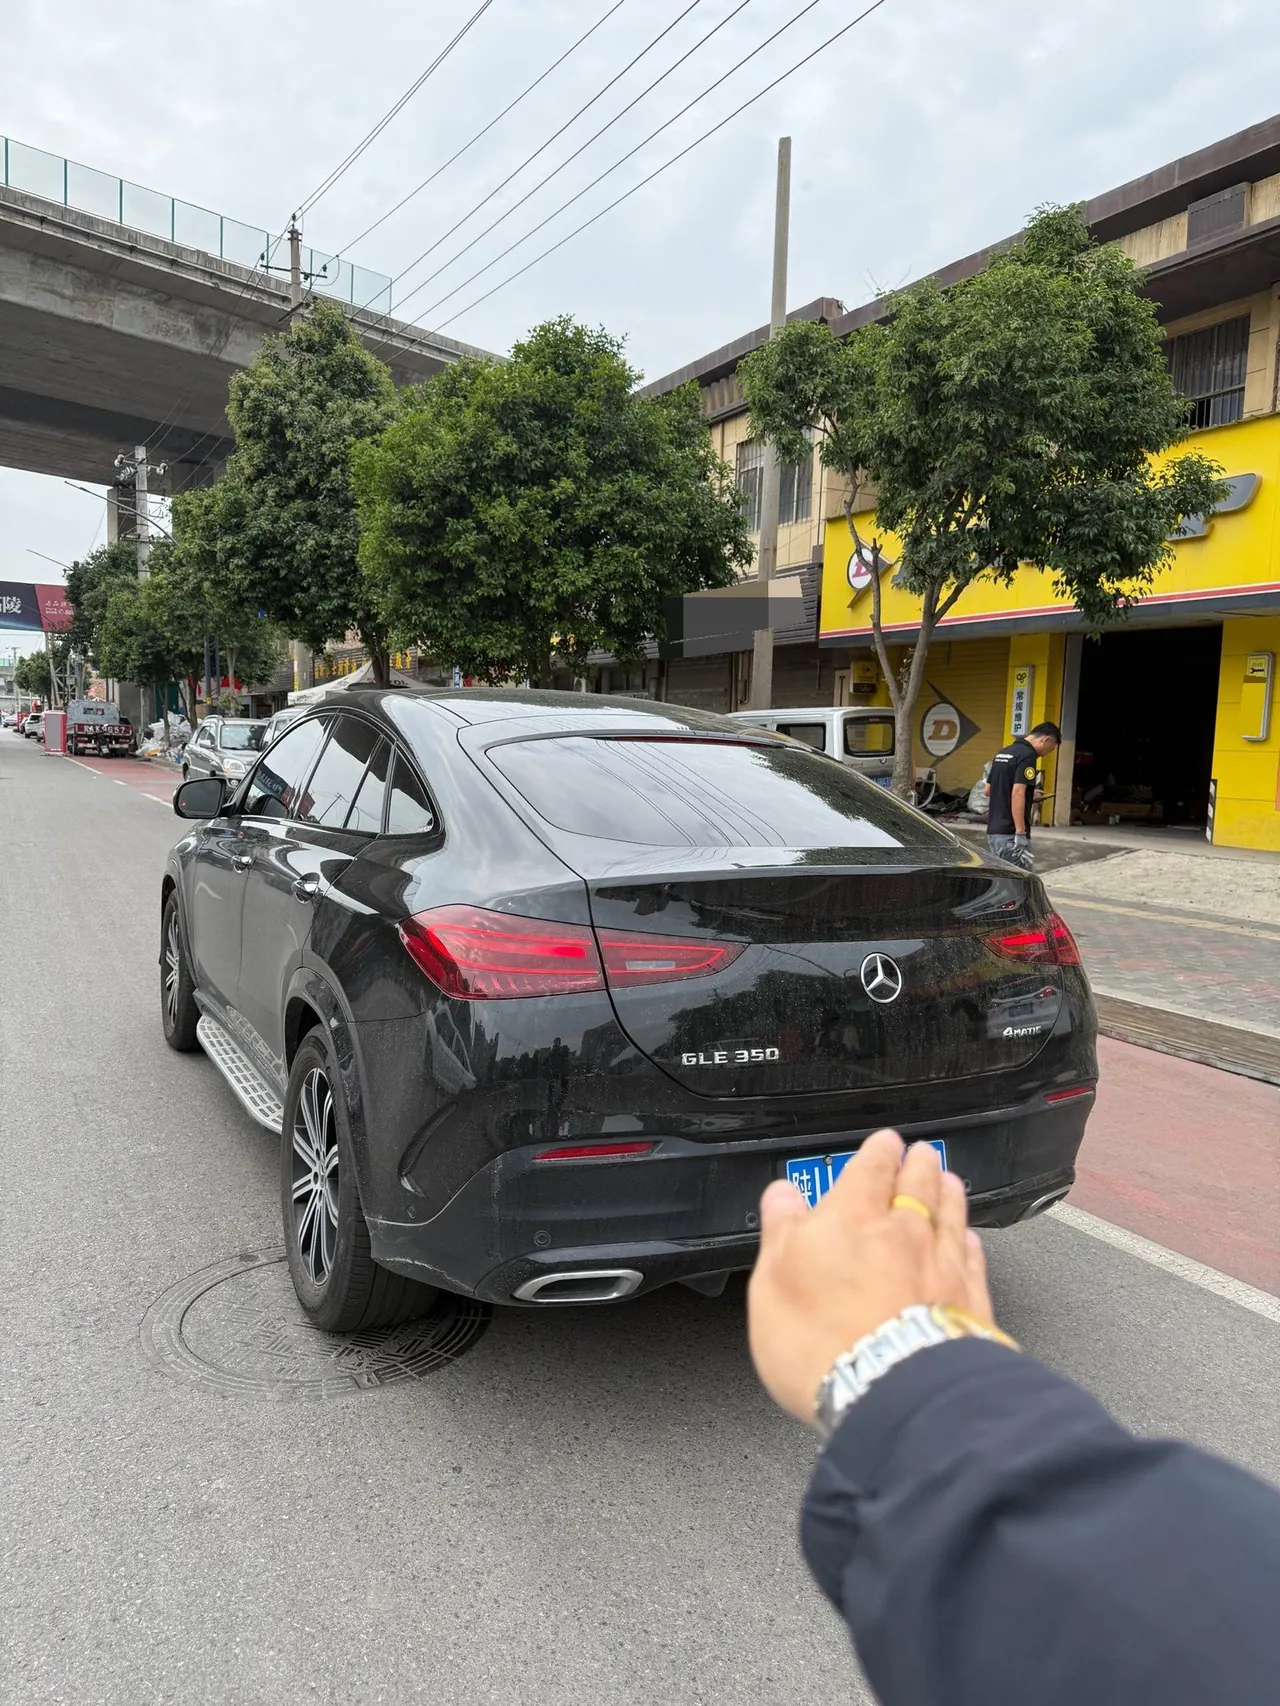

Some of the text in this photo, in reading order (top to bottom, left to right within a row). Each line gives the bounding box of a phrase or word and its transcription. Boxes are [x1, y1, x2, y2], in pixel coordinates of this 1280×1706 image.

[0, 595, 22, 614] 陵
[927, 719, 958, 741] D
[1002, 1025, 1042, 1038] 4MATIC
[681, 1047, 779, 1066] GLE 350
